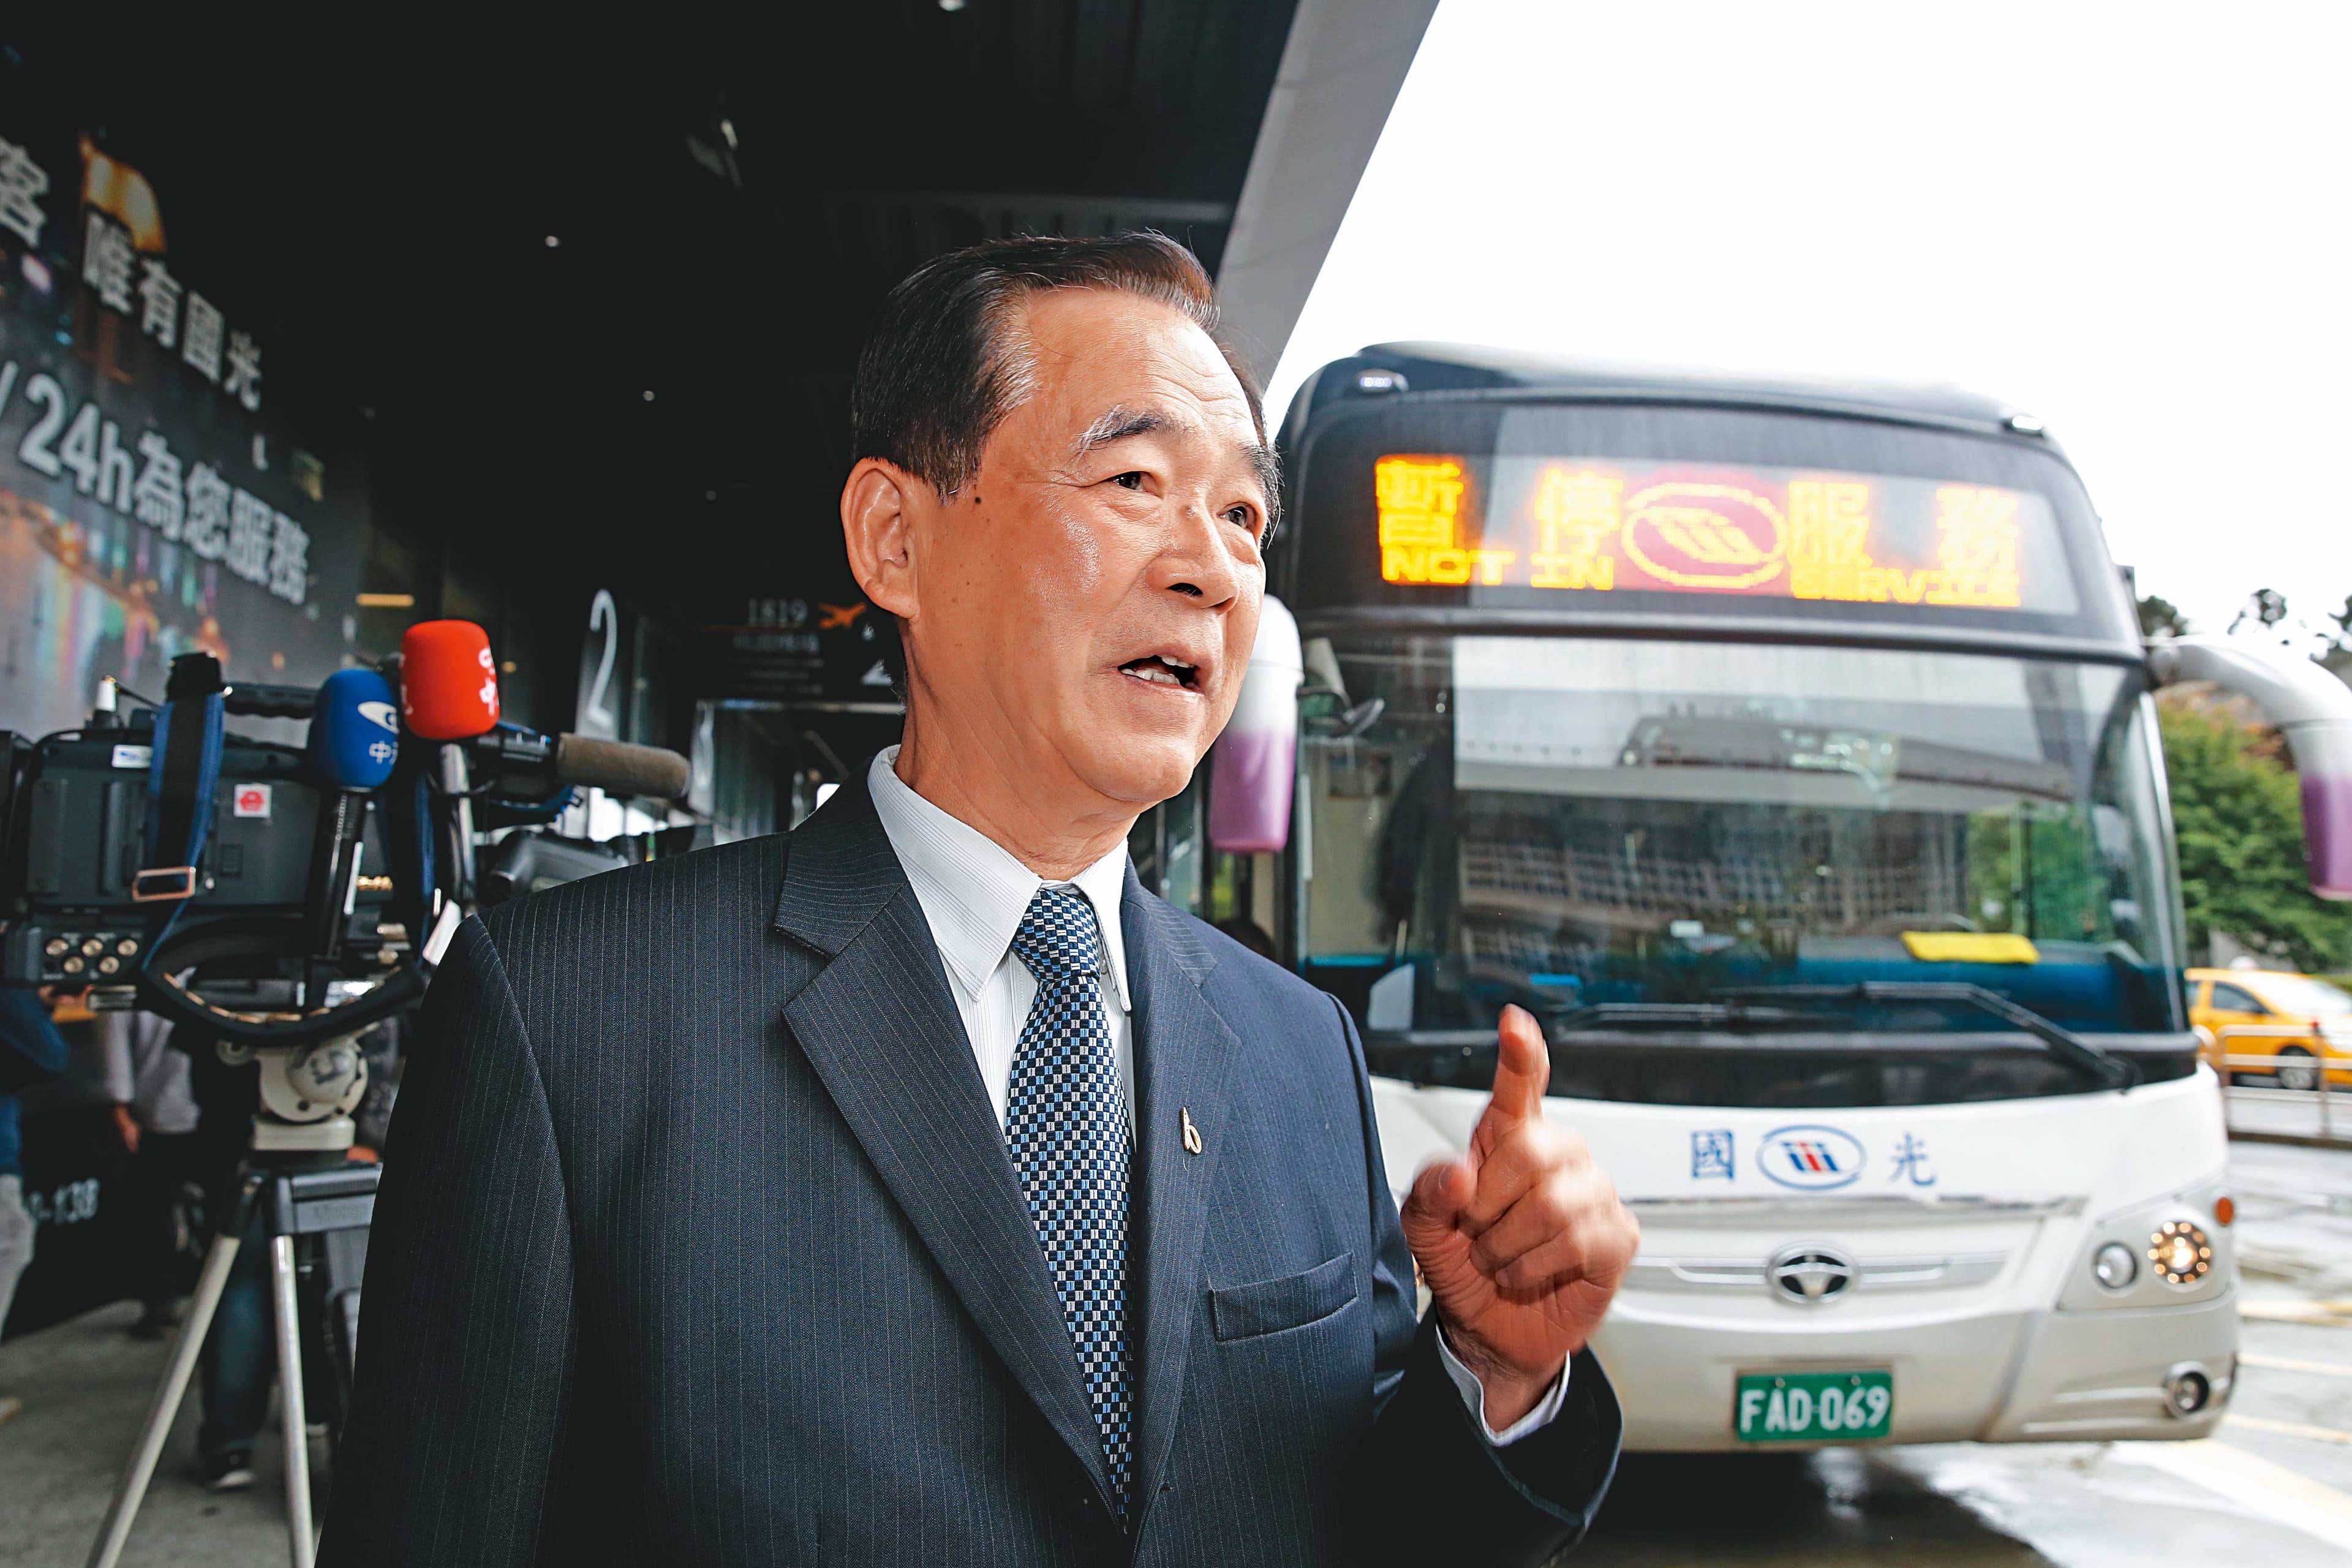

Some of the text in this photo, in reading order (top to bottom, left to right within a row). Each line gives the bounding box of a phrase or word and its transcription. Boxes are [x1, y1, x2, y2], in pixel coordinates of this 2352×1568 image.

[1382, 548, 1515, 586] NOT
[1531, 554, 1614, 590] IN
[586, 588, 617, 730] 2
[1691, 1129, 1938, 1187] 國 光
[1739, 1384, 1891, 1433] FAD-069
